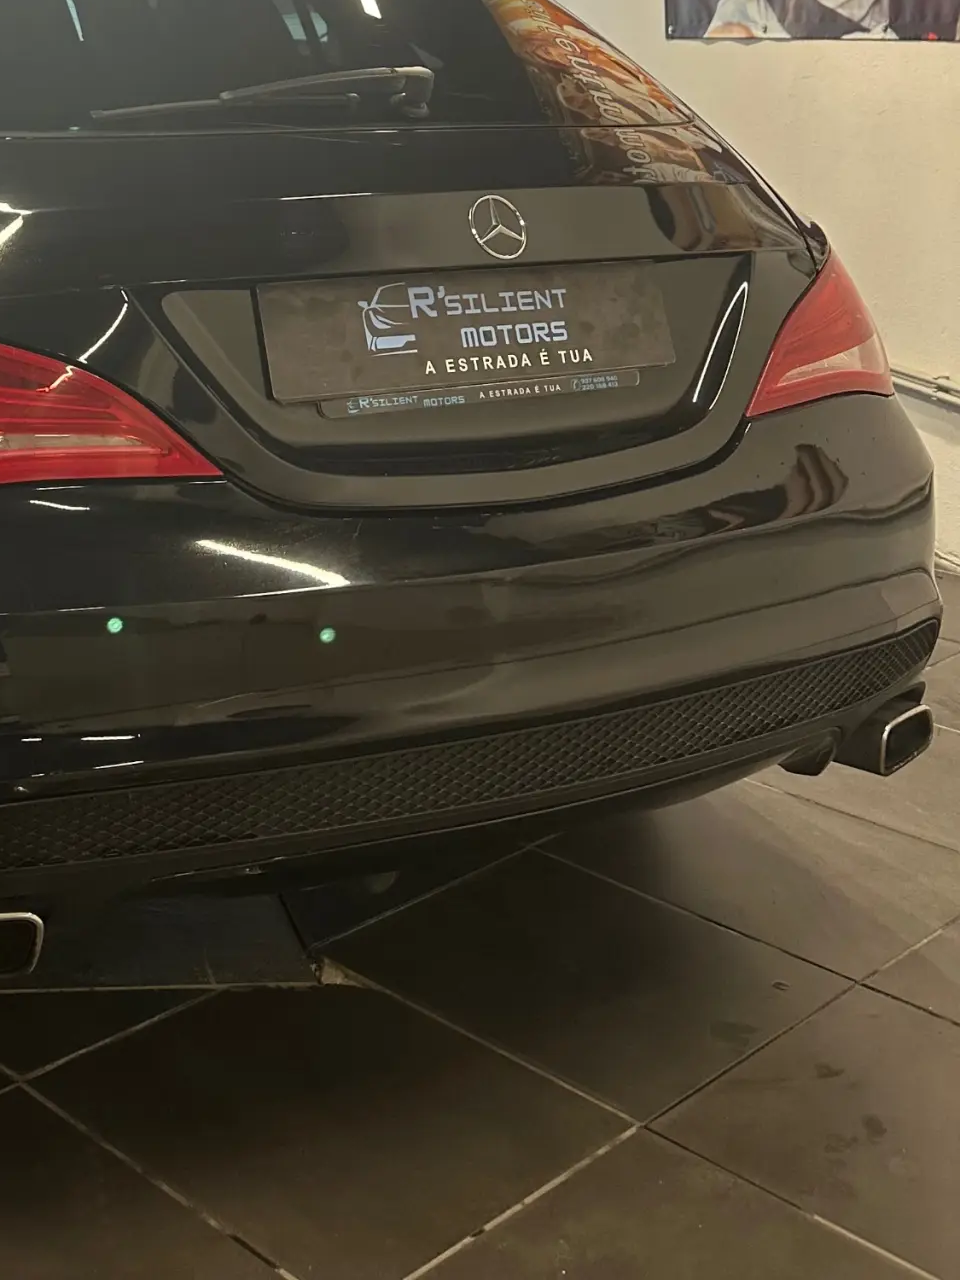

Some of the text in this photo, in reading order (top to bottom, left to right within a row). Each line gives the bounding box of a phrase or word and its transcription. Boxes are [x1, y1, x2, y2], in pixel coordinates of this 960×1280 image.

[407, 286, 567, 319] R'SILIENT
[460, 321, 569, 348] MOTORS
[425, 348, 593, 375] A ESTRADA É TUA
[423, 395, 466, 408] MOTORS
[479, 391, 486, 399] A
[489, 388, 531, 398] ESTRADA
[543, 384, 561, 392] TUA
